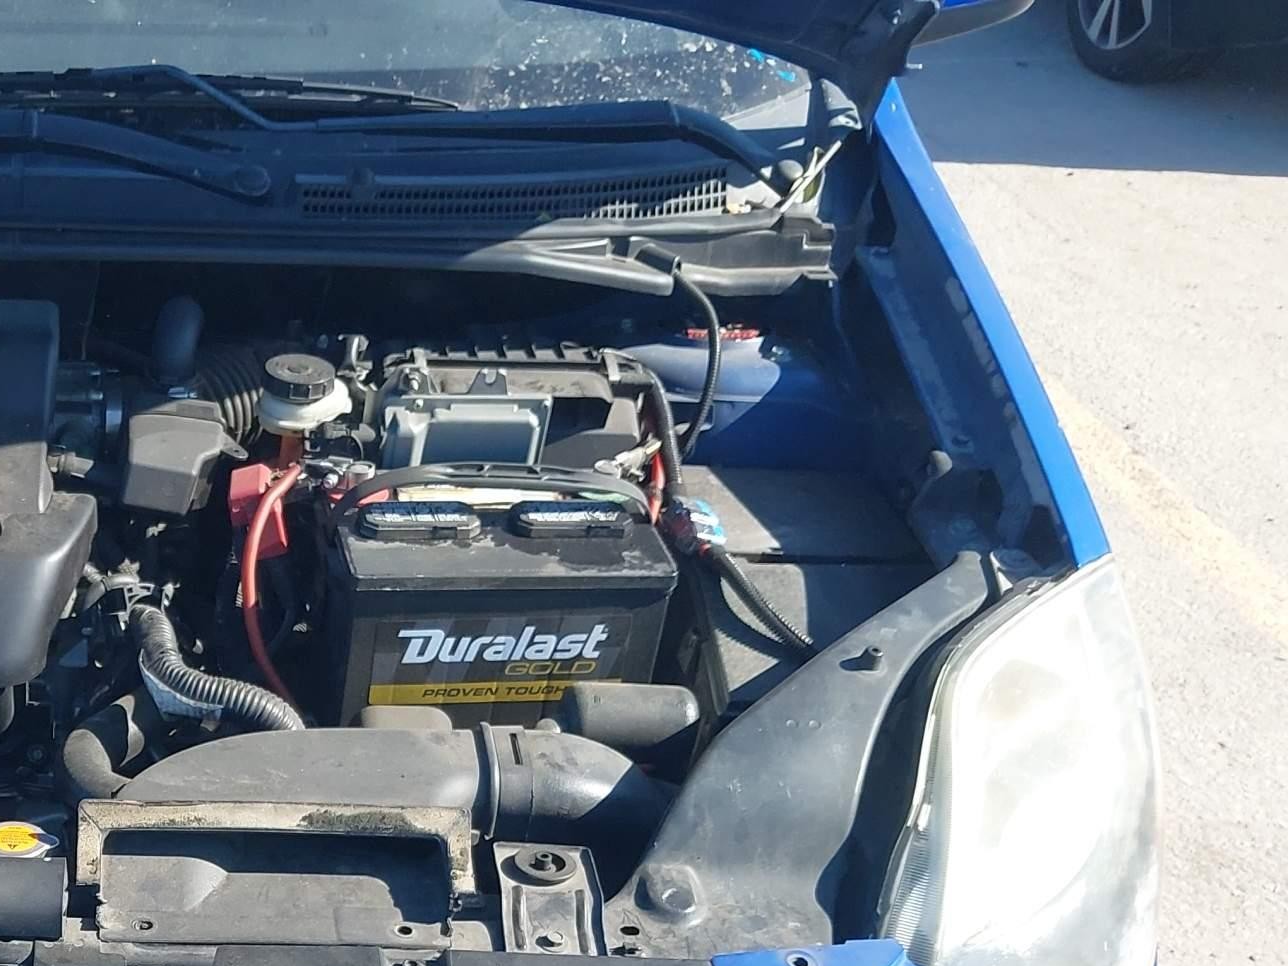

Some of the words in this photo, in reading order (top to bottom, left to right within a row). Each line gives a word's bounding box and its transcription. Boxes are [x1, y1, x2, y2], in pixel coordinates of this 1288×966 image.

[397, 624, 608, 664] Duralast
[504, 661, 597, 676] GOLD
[422, 687, 498, 698] PROVEN
[504, 684, 569, 696] TOUGH
